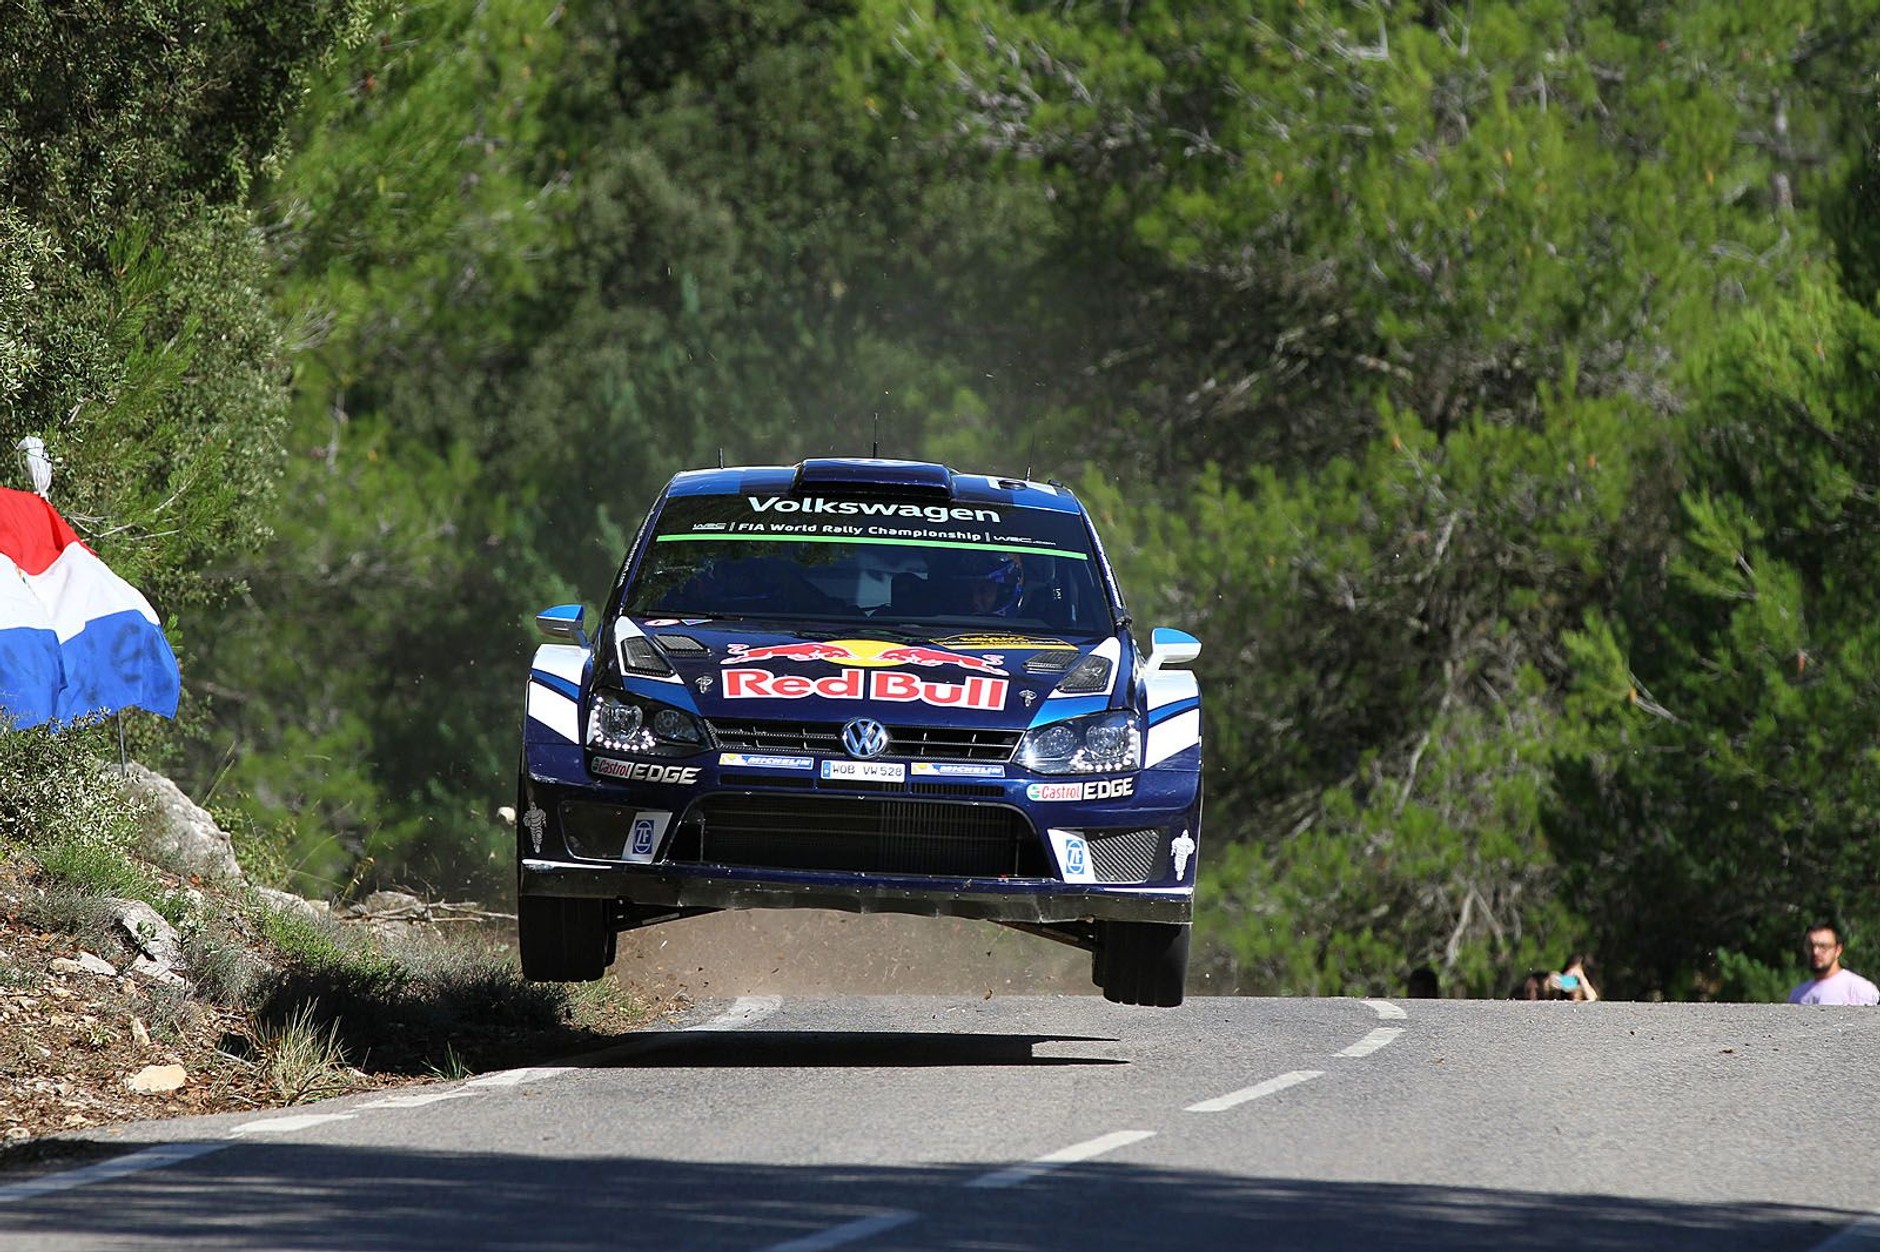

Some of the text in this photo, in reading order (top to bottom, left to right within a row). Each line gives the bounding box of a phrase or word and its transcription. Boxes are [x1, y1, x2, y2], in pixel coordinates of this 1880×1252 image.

[748, 496, 1001, 523] Volkswagen
[738, 523, 765, 531] FIA
[770, 523, 817, 532] World
[822, 524, 863, 535] Rally
[868, 526, 981, 541] Championship
[723, 669, 1006, 709] Red Bull
[599, 759, 702, 784] Castrol EDGE
[1041, 777, 1134, 800] Castrol EDGE
